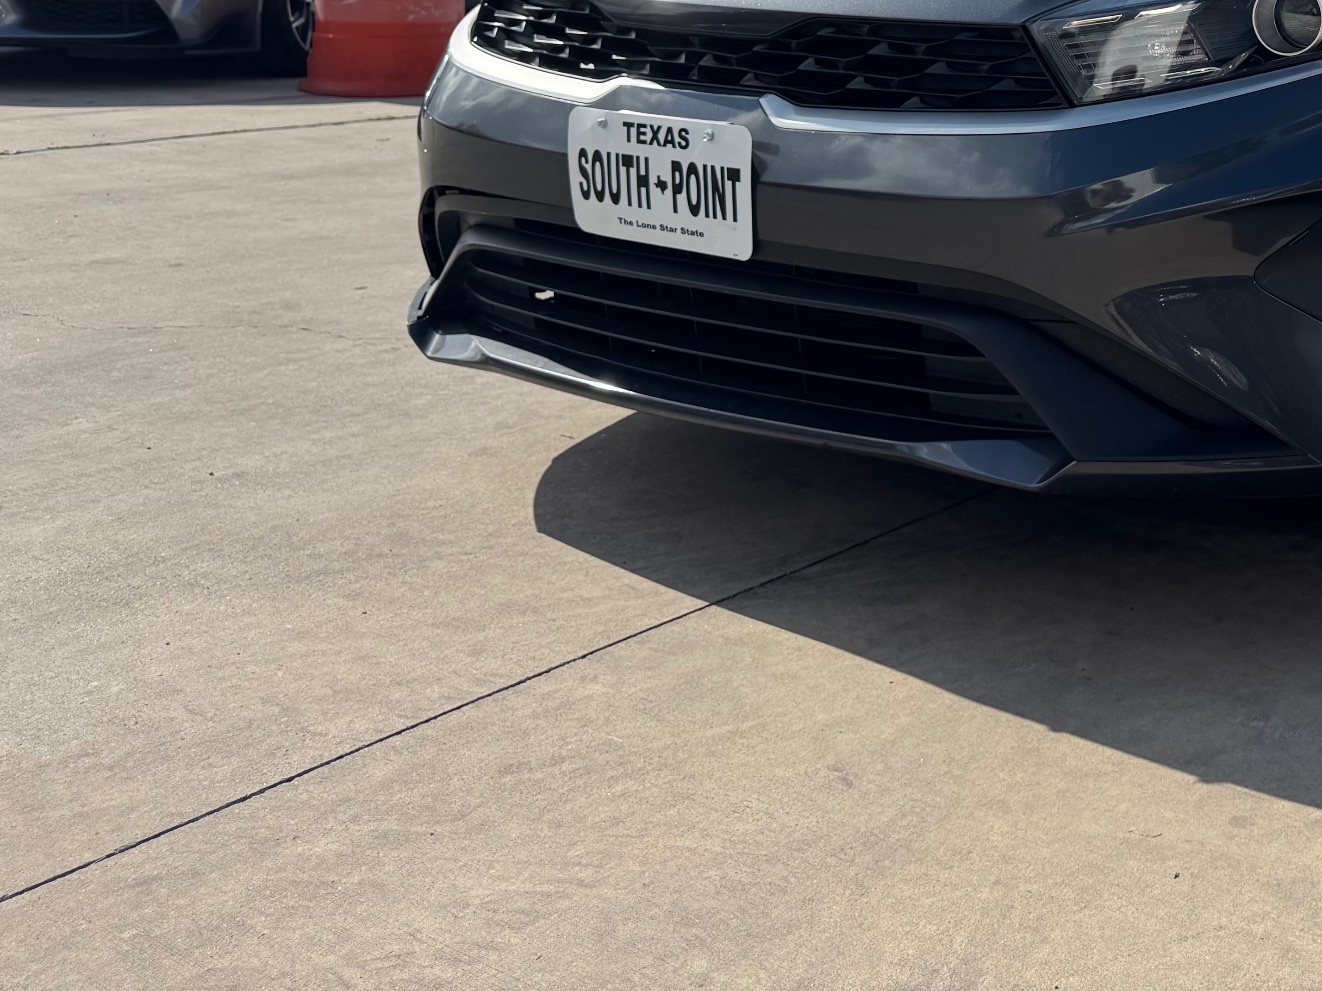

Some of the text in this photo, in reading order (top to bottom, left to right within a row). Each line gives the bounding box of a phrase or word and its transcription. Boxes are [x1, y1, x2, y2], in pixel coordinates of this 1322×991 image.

[623, 121, 690, 150] TEXAS
[578, 147, 741, 223] SOUTH POINT
[617, 216, 705, 238] The Lone Star State
